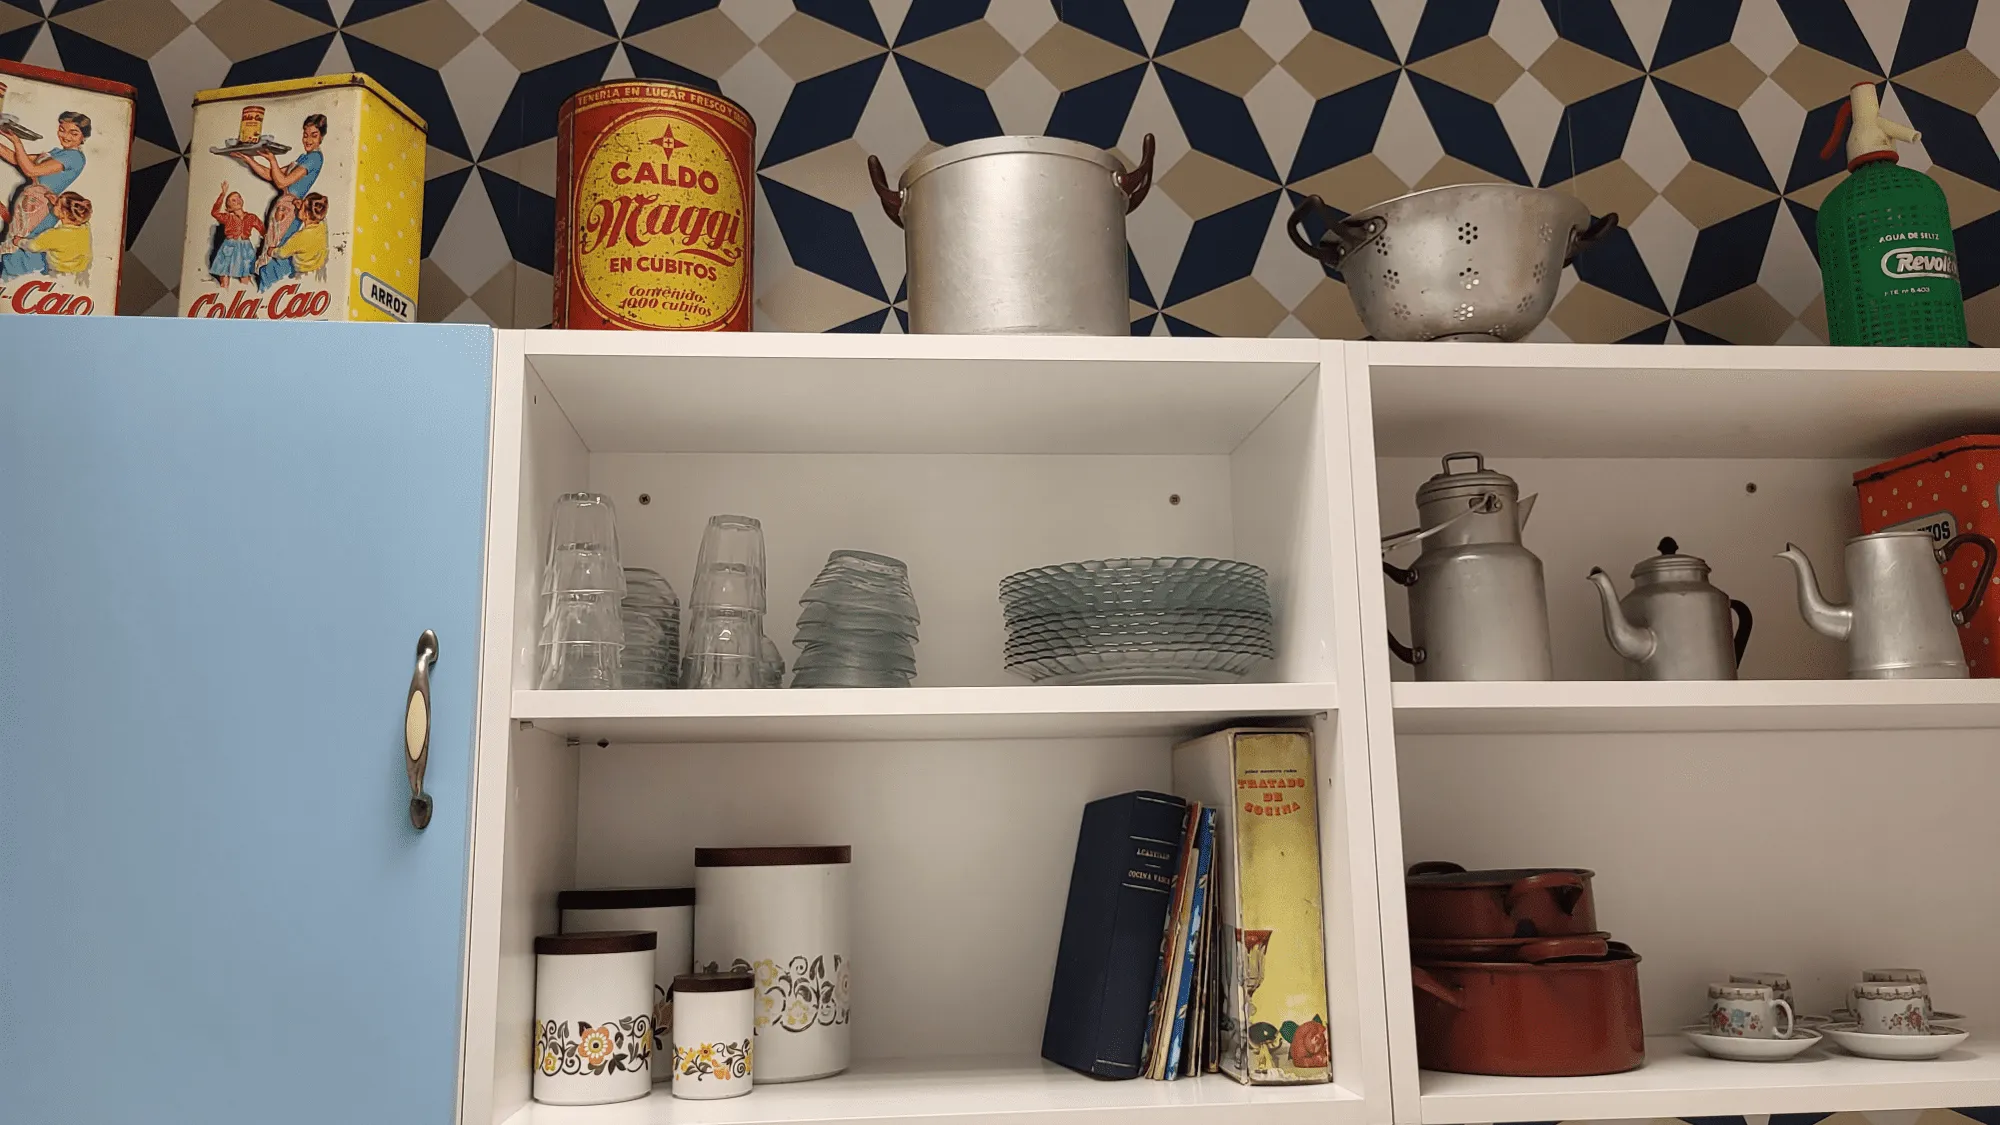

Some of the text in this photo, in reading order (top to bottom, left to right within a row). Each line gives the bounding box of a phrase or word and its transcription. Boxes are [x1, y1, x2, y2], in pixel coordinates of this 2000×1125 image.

[624, 87, 640, 96] EN
[645, 87, 686, 101] LUGAR
[689, 93, 726, 113] FRESCO
[610, 161, 720, 195] CALDO
[582, 193, 744, 267] Maggi
[1879, 232, 1906, 244] AGUA
[1907, 232, 1918, 240] DE
[609, 255, 718, 282] EN CUBITOS
[0, 280, 94, 316] -Cao
[187, 283, 331, 320] Cola-Cao
[370, 283, 408, 318] ARROZ
[619, 297, 712, 318] 1000 cubitos
[1237, 778, 1305, 789] TRATADO
[1262, 791, 1283, 802] DE
[1243, 801, 1301, 817] COCINA
